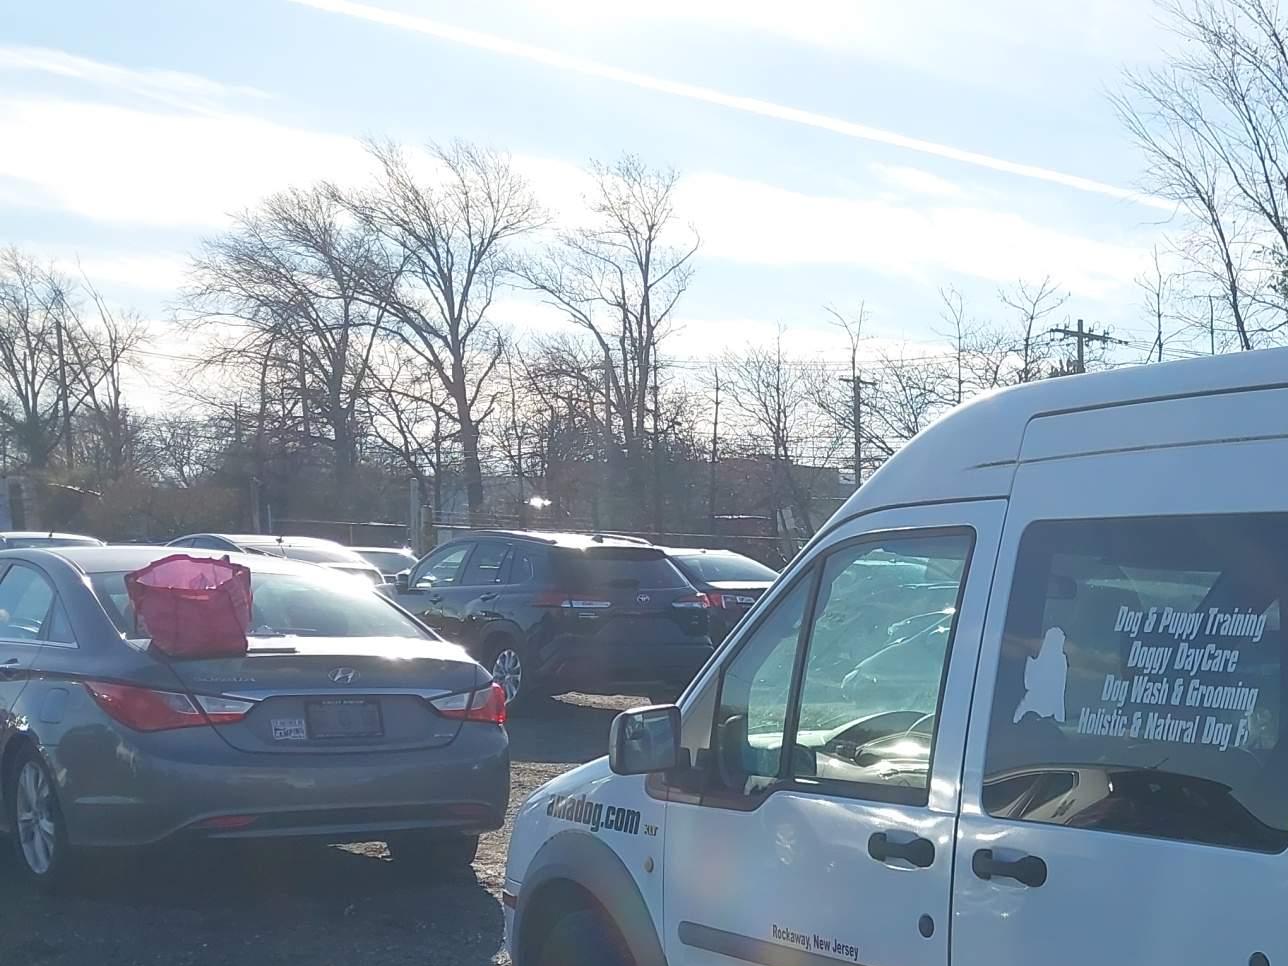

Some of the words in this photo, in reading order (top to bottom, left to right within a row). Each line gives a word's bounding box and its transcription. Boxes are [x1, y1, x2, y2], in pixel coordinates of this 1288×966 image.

[1114, 606, 1143, 637] Dog
[1143, 607, 1157, 632] &
[1158, 607, 1204, 640] Puppy
[1205, 608, 1266, 642] Training
[1128, 641, 1173, 674] Doggy
[1174, 643, 1239, 676] DayCare
[1102, 674, 1129, 707] Dog
[1130, 676, 1169, 704] Wash
[1171, 678, 1184, 705] &
[1186, 679, 1259, 716] Grooming
[1078, 707, 1127, 737] Holistic
[1130, 711, 1142, 738] &
[1144, 712, 1200, 743] Natural
[1201, 716, 1232, 751] Dog
[772, 924, 812, 951] Rockaway,
[813, 934, 831, 951] New
[832, 938, 859, 961] Jersey
